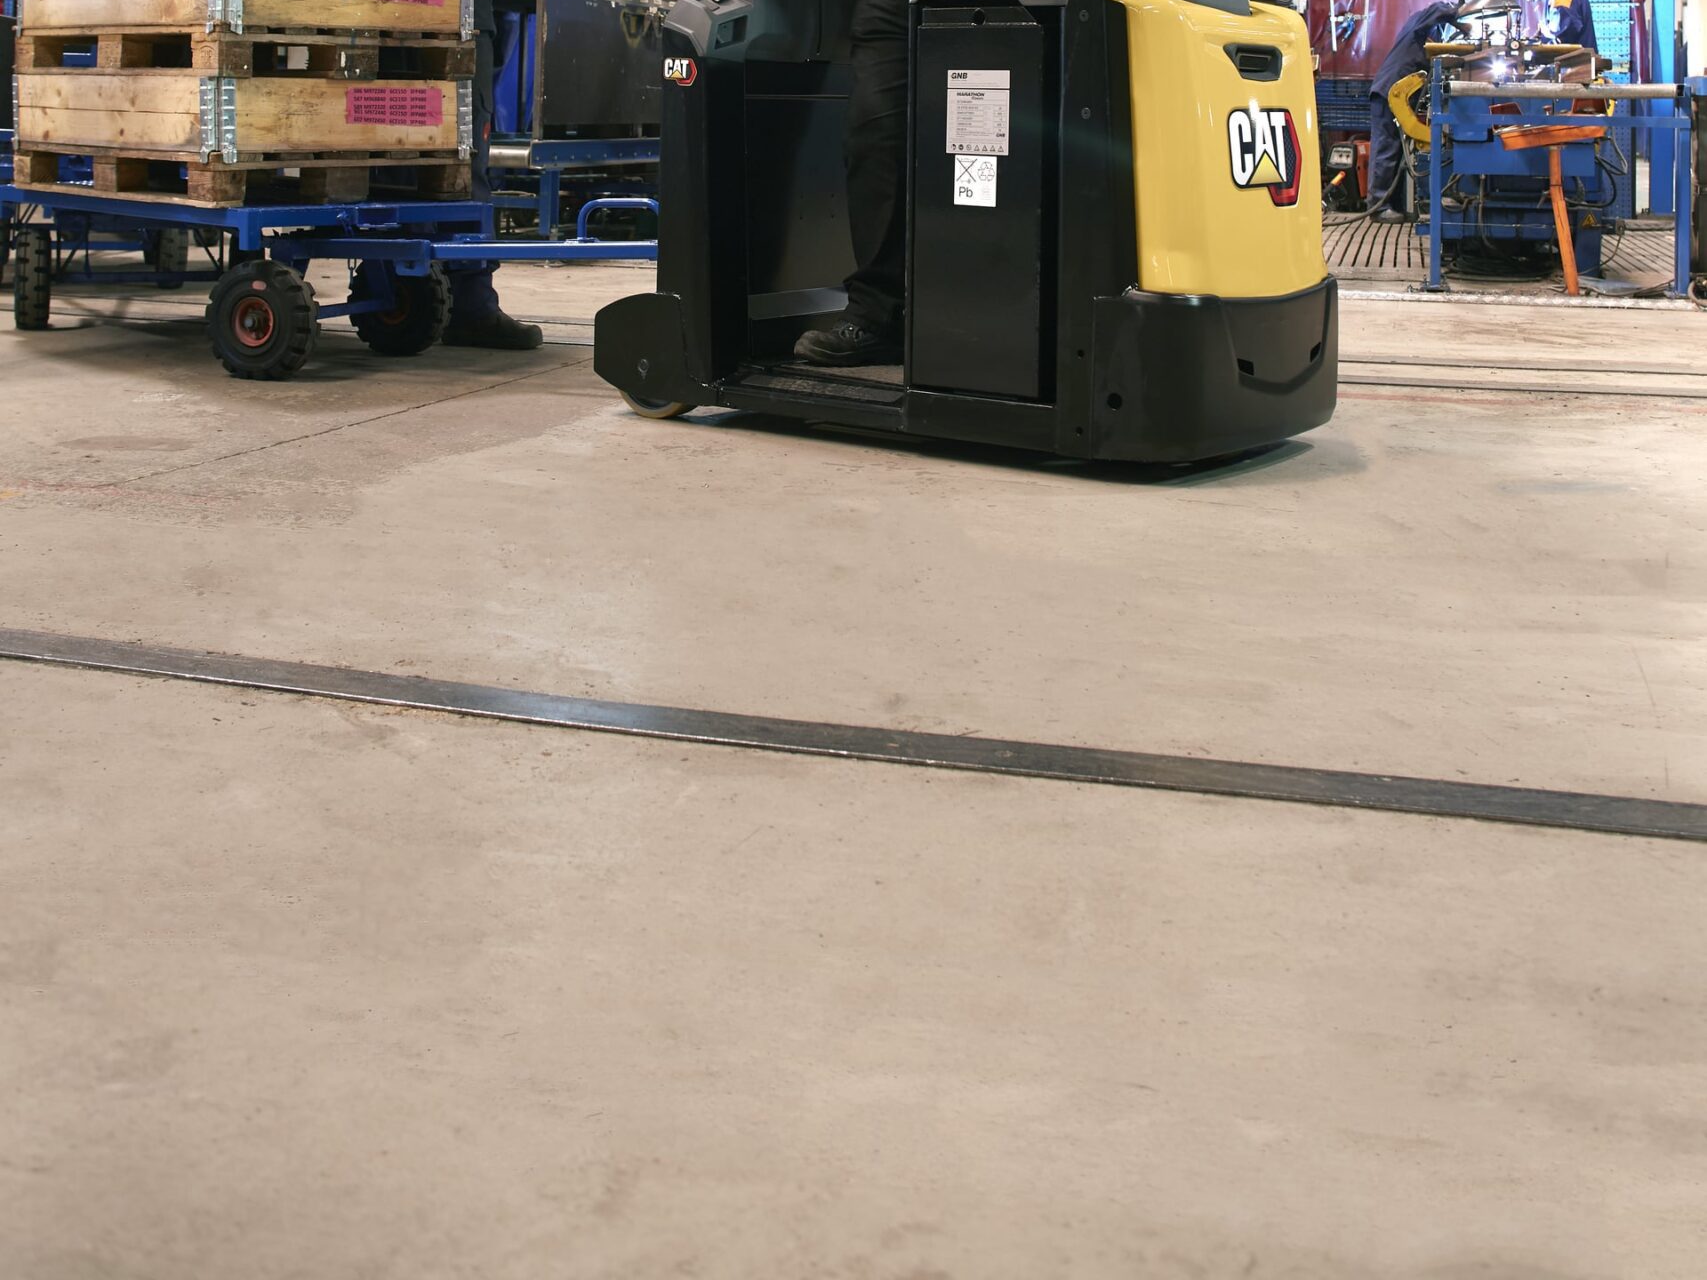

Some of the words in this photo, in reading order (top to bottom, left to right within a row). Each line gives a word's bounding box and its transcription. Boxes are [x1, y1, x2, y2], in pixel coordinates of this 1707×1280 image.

[664, 58, 689, 79] CAT
[951, 72, 968, 80] GNB
[1229, 110, 1287, 186] CAT
[958, 186, 974, 198] Pb
